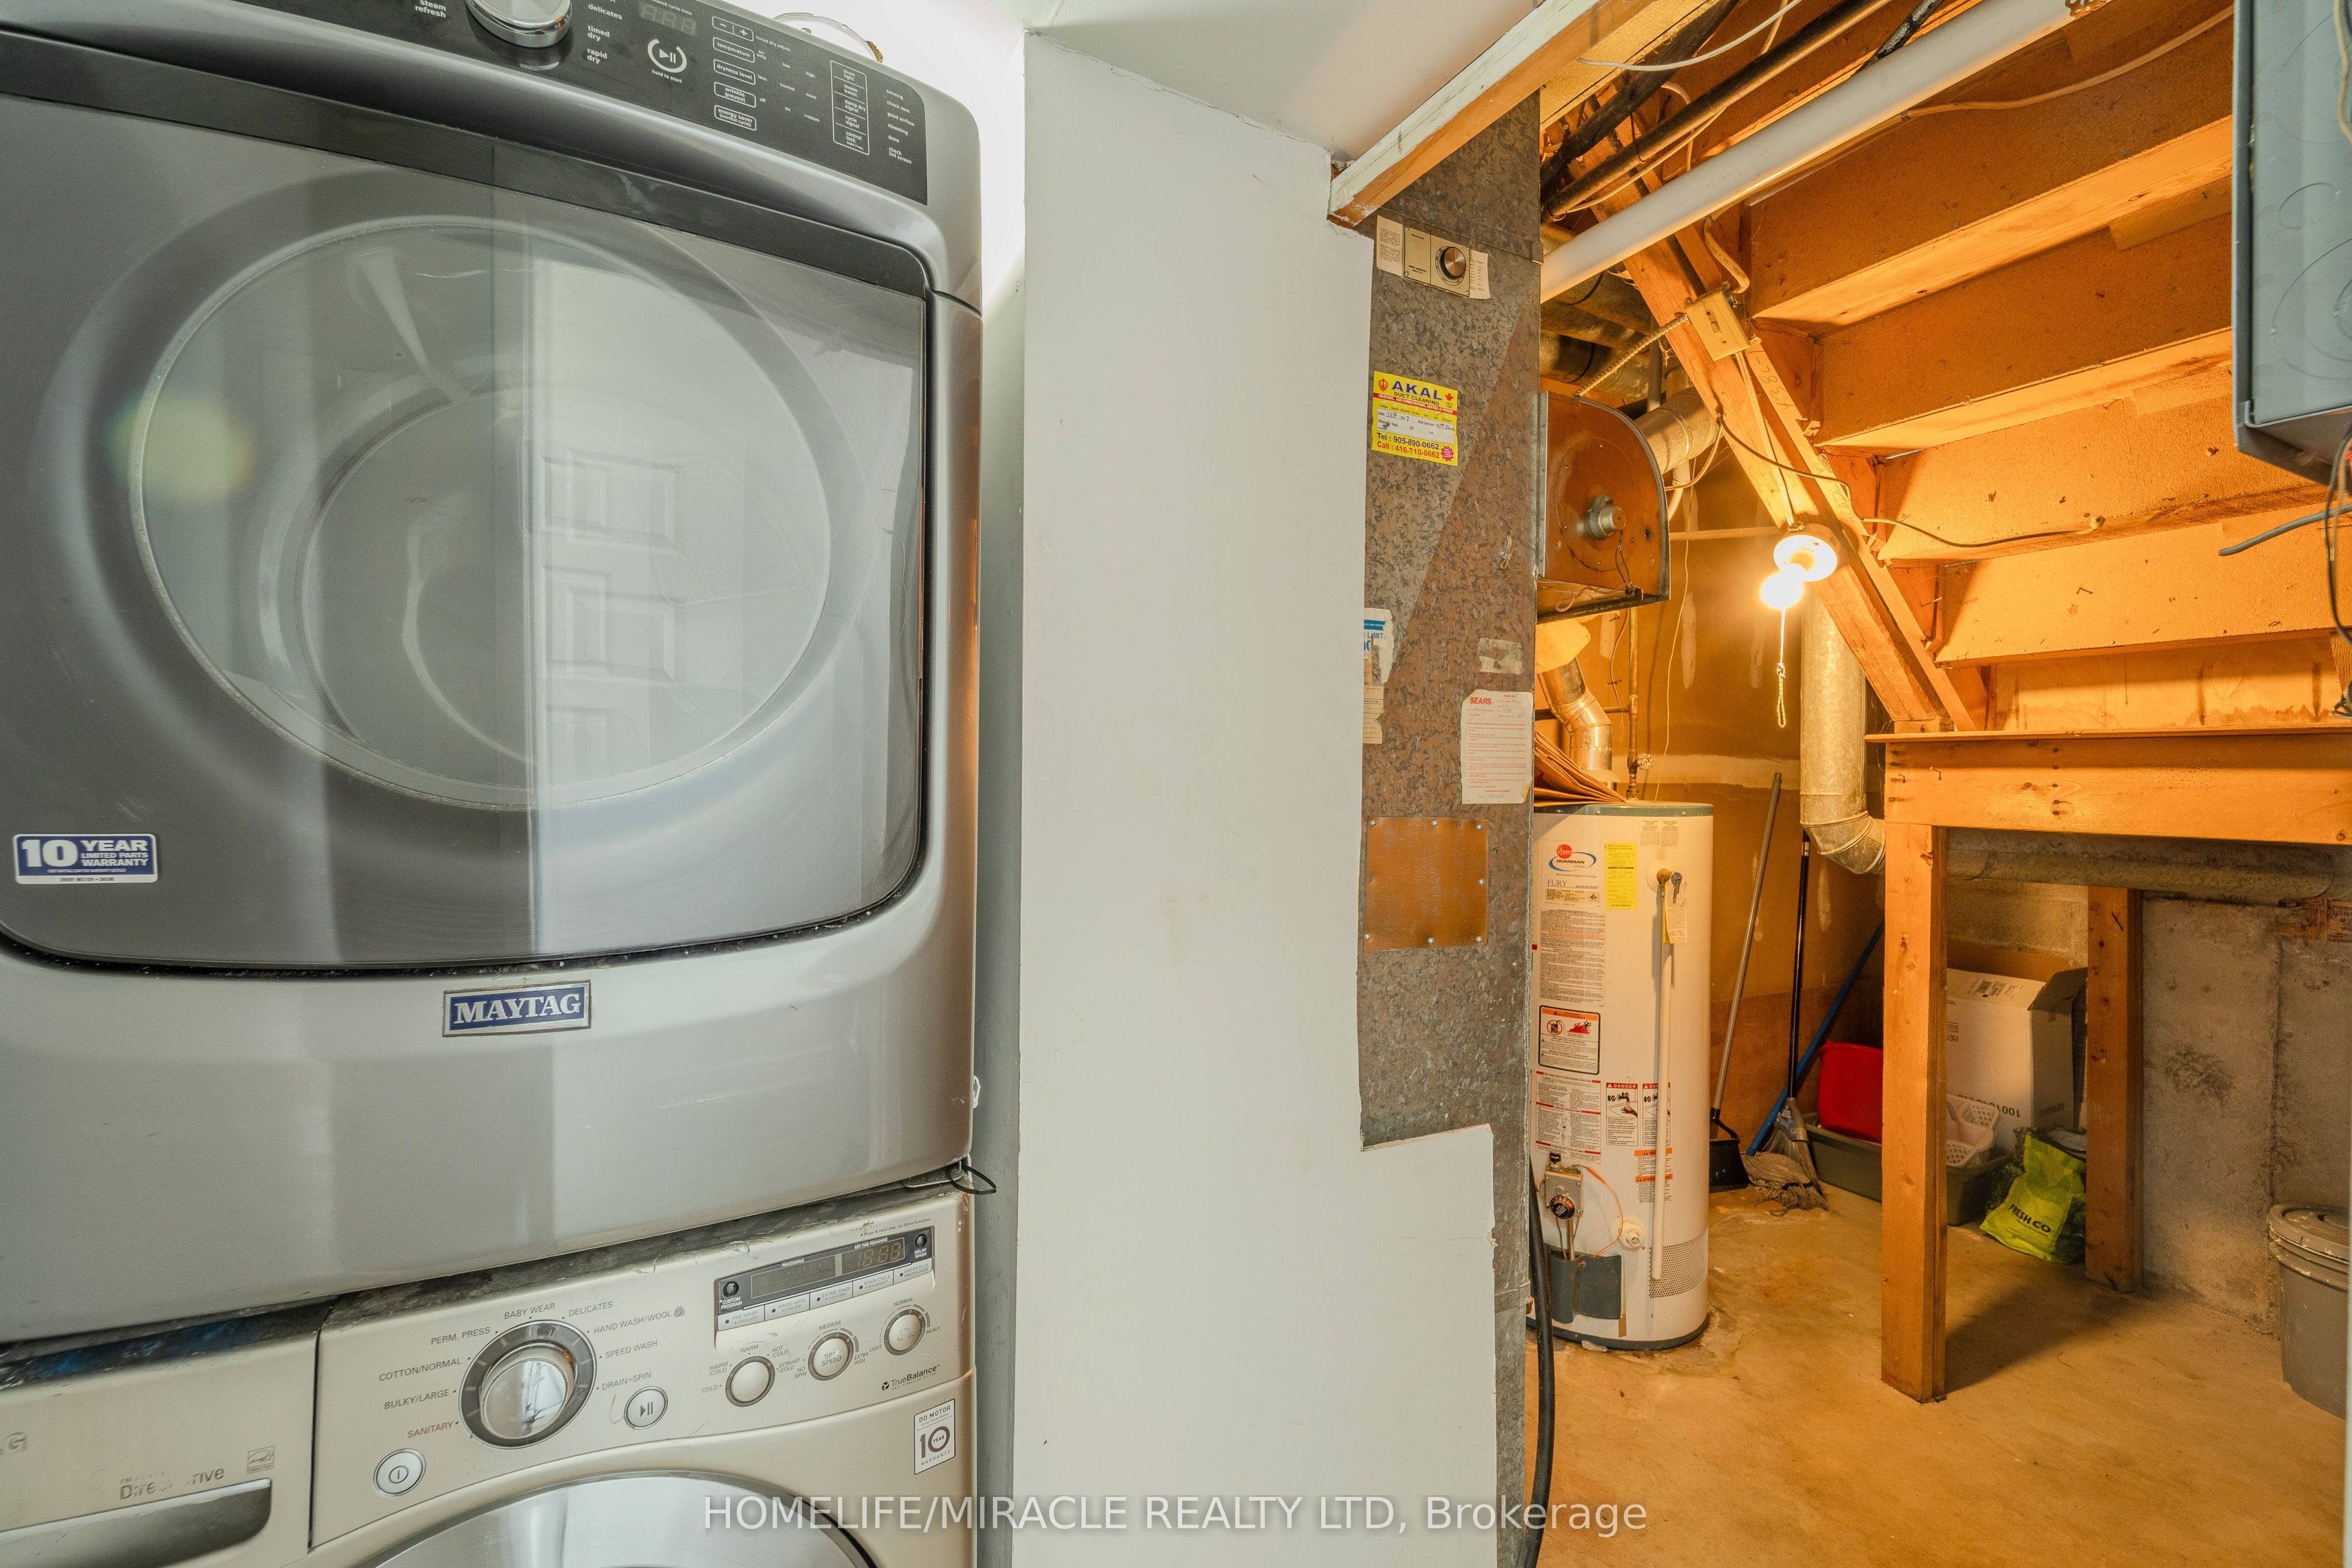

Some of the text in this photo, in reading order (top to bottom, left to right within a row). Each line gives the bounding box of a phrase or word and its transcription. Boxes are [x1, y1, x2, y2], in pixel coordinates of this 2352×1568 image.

[420, 0, 447, 11] steam
[415, 5, 446, 18] refresh
[588, 3, 622, 20] delicates
[587, 24, 610, 38] timed
[587, 32, 601, 42] dry
[587, 48, 608, 59] rapid
[717, 42, 750, 58] temperature
[587, 54, 601, 64] dry
[652, 69, 663, 78] hold
[670, 75, 682, 84] start
[717, 64, 752, 80] dryness level
[843, 69, 855, 77] drum
[725, 86, 745, 97] wrinkle
[780, 83, 795, 92] normal
[844, 84, 858, 92] steam
[844, 89, 858, 97] boost
[725, 92, 745, 103] prevent
[886, 89, 903, 100] sensing
[845, 99, 858, 108] damp
[845, 105, 859, 113] signal
[887, 100, 900, 109] check
[718, 108, 753, 124] energy saver
[845, 115, 857, 124] cycle
[888, 112, 915, 127] good airflow
[846, 121, 859, 129] signal
[888, 124, 908, 136] steaming
[846, 131, 862, 141] control
[888, 135, 900, 143] done
[889, 147, 902, 156] check
[897, 156, 912, 165] screen
[1392, 381, 1442, 401] AKAL
[1411, 395, 1440, 405] CLEANING
[1393, 436, 1439, 450] 905-890-0662
[1378, 441, 1389, 450] Call
[1395, 445, 1440, 458] 416-710-0662
[21, 839, 148, 867] 10 YEAR
[1557, 845, 1572, 856] Rheem
[1547, 879, 1567, 888] FURY
[454, 993, 581, 1024] MAYTAG
[2009, 1204, 2032, 1224] FRESH
[2032, 1220, 2051, 1233] CO
[870, 1237, 888, 1246] REMAINING
[782, 1259, 804, 1267] PROCESSING
[721, 1301, 742, 1310] PROGRAM
[722, 1296, 741, 1305] CUSTOM
[894, 1297, 914, 1306] NORMAL
[504, 1303, 555, 1319] BABY WEAR
[569, 1301, 613, 1317] DELICATES
[733, 1310, 758, 1321] PRE-WASH
[594, 1310, 672, 1334] HAND WASH/WOOL
[819, 1320, 841, 1330] MEDIUM
[431, 1327, 490, 1345] PERM. PRESS
[605, 1340, 658, 1359] SPEED WASH
[740, 1344, 759, 1353] WARM
[772, 1349, 788, 1358] /COLD
[821, 1355, 842, 1366] SPEED
[854, 1352, 869, 1360] EXTRA
[379, 1357, 462, 1382] COTTON/NORMAL
[709, 1362, 728, 1371] WARM
[779, 1360, 791, 1368] EXTRA
[779, 1365, 794, 1373] /COLD
[709, 1367, 726, 1376] /COLD
[601, 1371, 652, 1390] DRAIN+SPIN
[702, 1384, 718, 1393] COLD
[384, 1389, 449, 1409] BULKY/LARGE
[929, 1405, 951, 1419] MOTOR
[407, 1421, 453, 1439] SANITARY
[920, 1426, 951, 1459] 10
[933, 1435, 944, 1444] YEAR
[921, 1449, 951, 1466] WARRANTY
